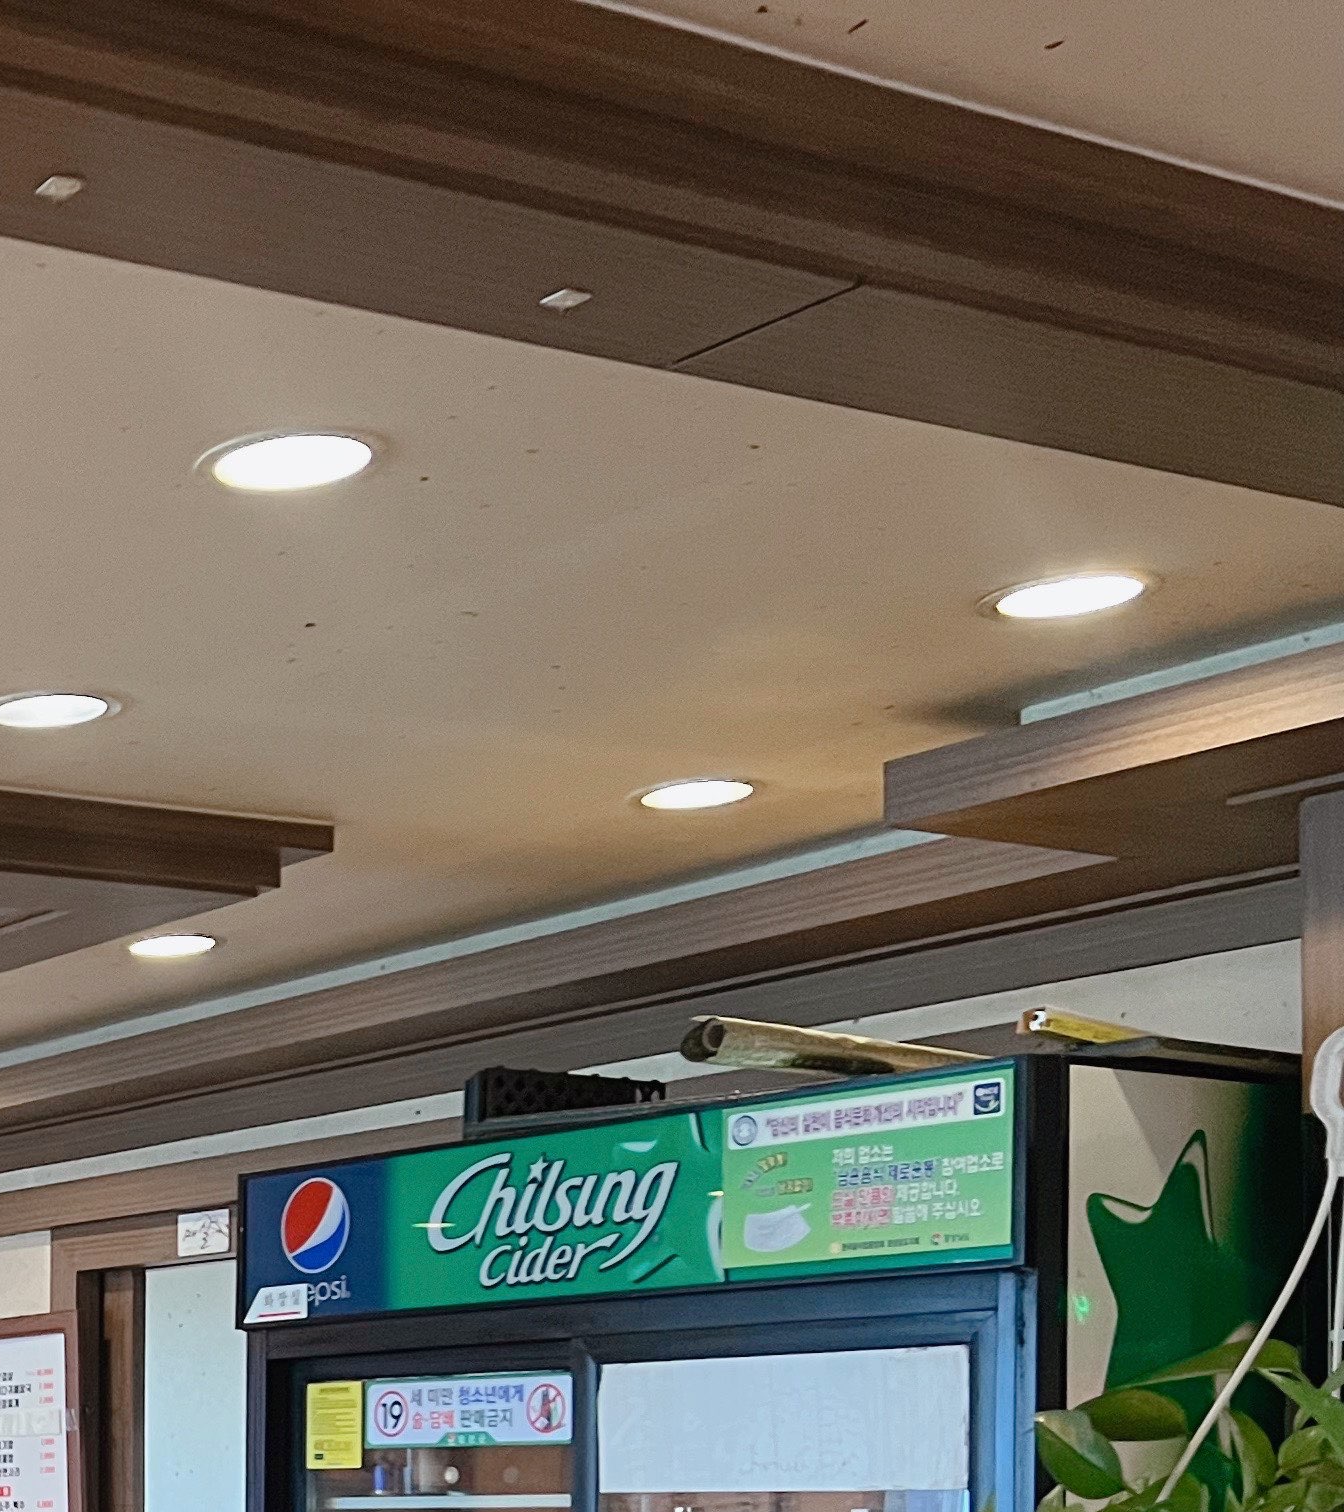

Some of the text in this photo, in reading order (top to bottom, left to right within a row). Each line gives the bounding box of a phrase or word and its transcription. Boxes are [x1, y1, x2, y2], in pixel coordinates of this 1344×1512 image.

[427, 1152, 680, 1270] Chilsung
[306, 1275, 348, 1307] epsi
[458, 1384, 525, 1406] 청소년에게
[381, 1400, 404, 1430] 19
[460, 1407, 513, 1429] 판매금지
